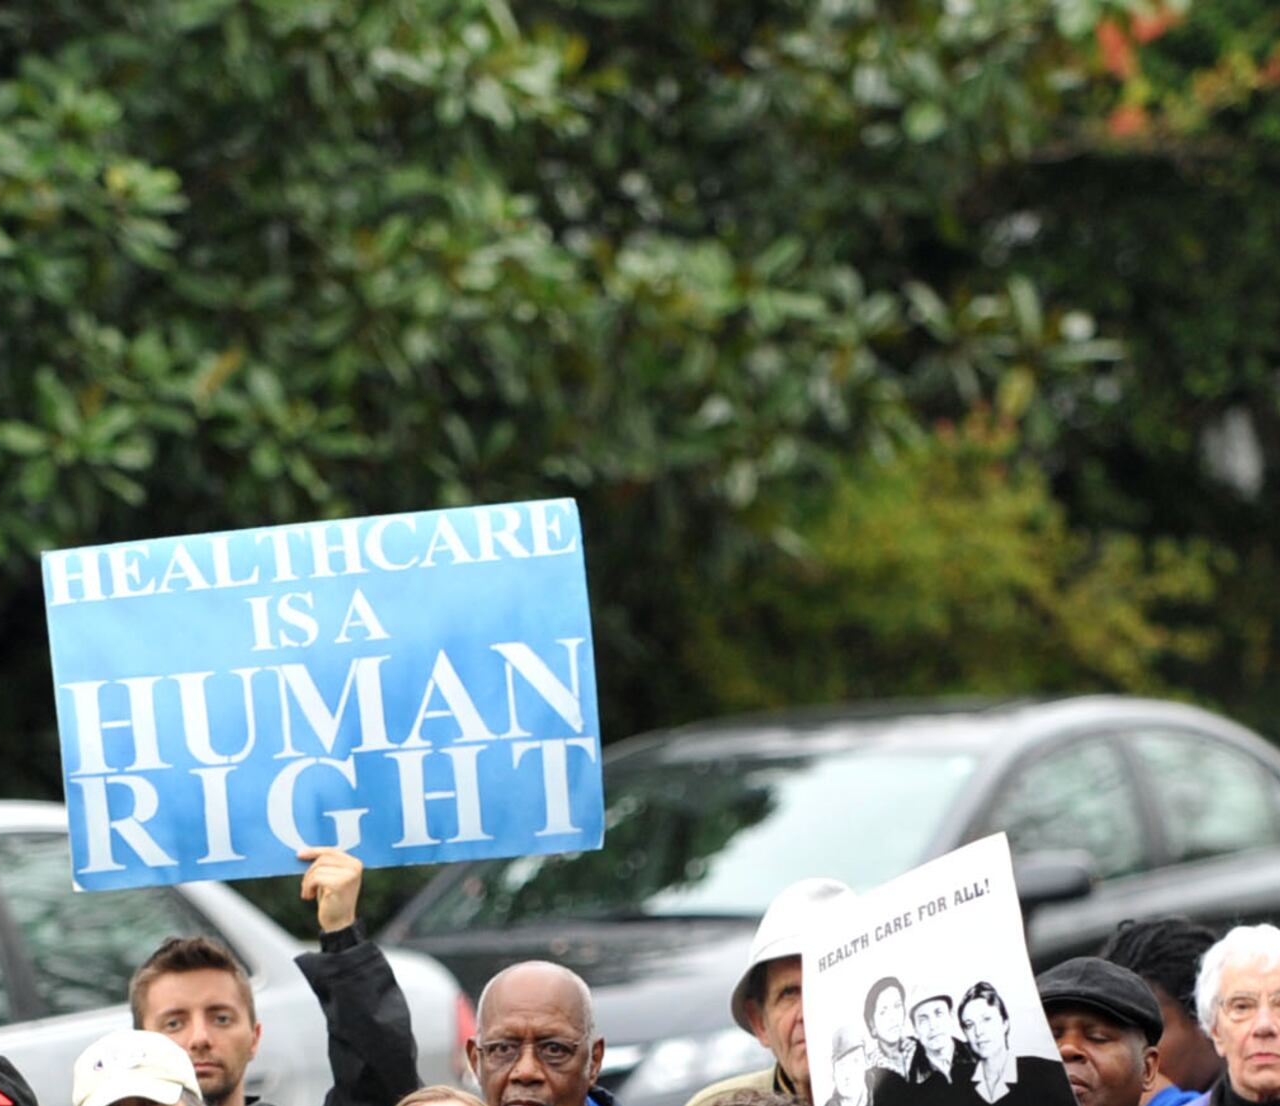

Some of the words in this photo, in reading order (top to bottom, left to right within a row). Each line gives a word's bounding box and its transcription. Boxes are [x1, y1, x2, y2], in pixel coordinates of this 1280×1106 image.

[50, 502, 577, 606] HEALTHCARE
[245, 589, 320, 651] IS
[335, 588, 391, 643] A
[59, 637, 586, 776] HUMAN
[70, 737, 597, 873] RIGHT
[818, 933, 870, 973] HEALTH
[875, 911, 913, 942] CARE
[918, 896, 948, 922] FOR
[953, 877, 991, 906] ALL!
